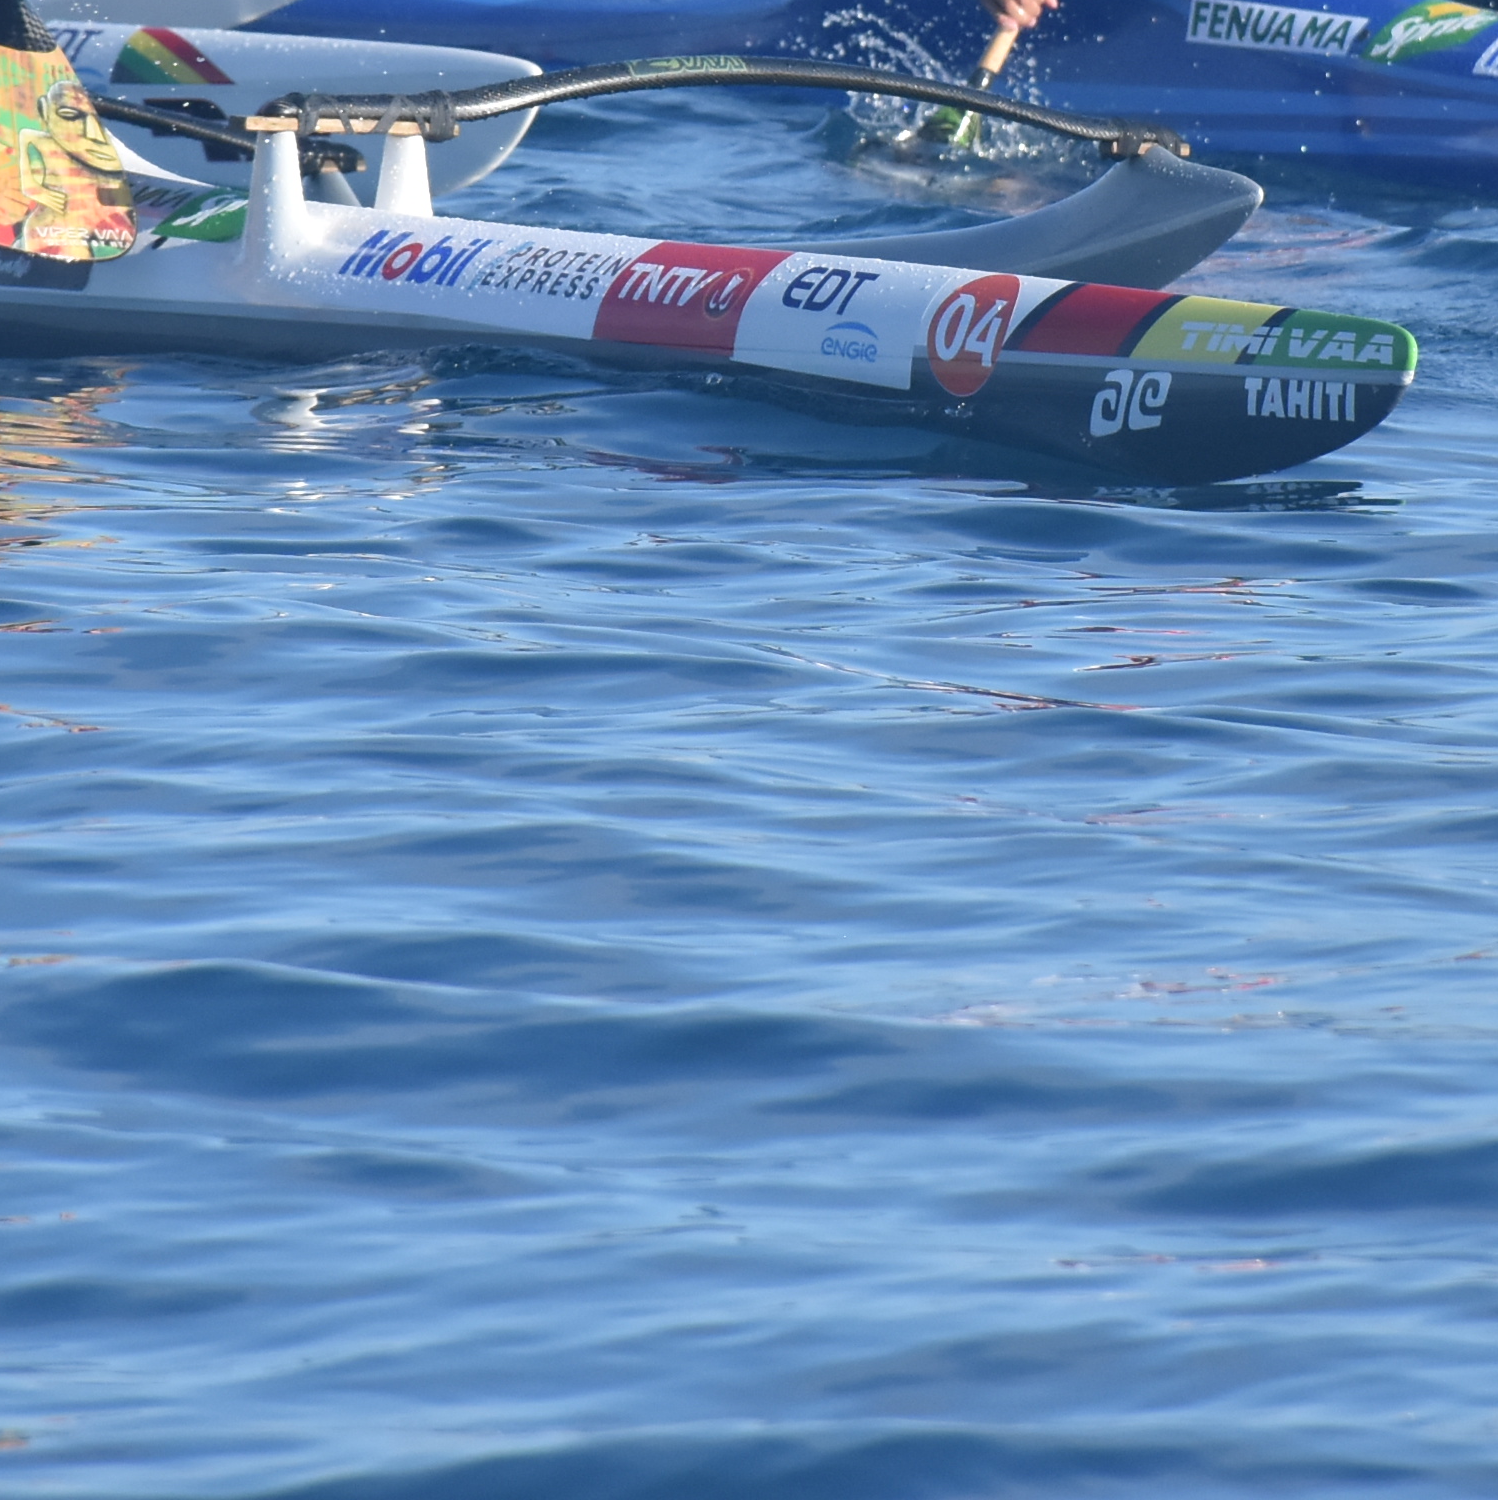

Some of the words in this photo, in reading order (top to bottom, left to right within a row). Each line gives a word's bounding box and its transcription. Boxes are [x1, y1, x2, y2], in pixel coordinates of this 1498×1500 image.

[1191, 1, 1295, 43] FENUA
[1298, 14, 1351, 51] MA
[35, 226, 90, 240] VIPER
[338, 228, 495, 288] Mobil
[507, 245, 633, 278] PROTEIN
[480, 264, 600, 301] EXPRESS
[616, 261, 724, 307] TNTV
[782, 265, 881, 316] EDT
[933, 292, 1009, 369] 04
[1286, 325, 1396, 366] VAA
[1244, 376, 1357, 424] TAHITI
